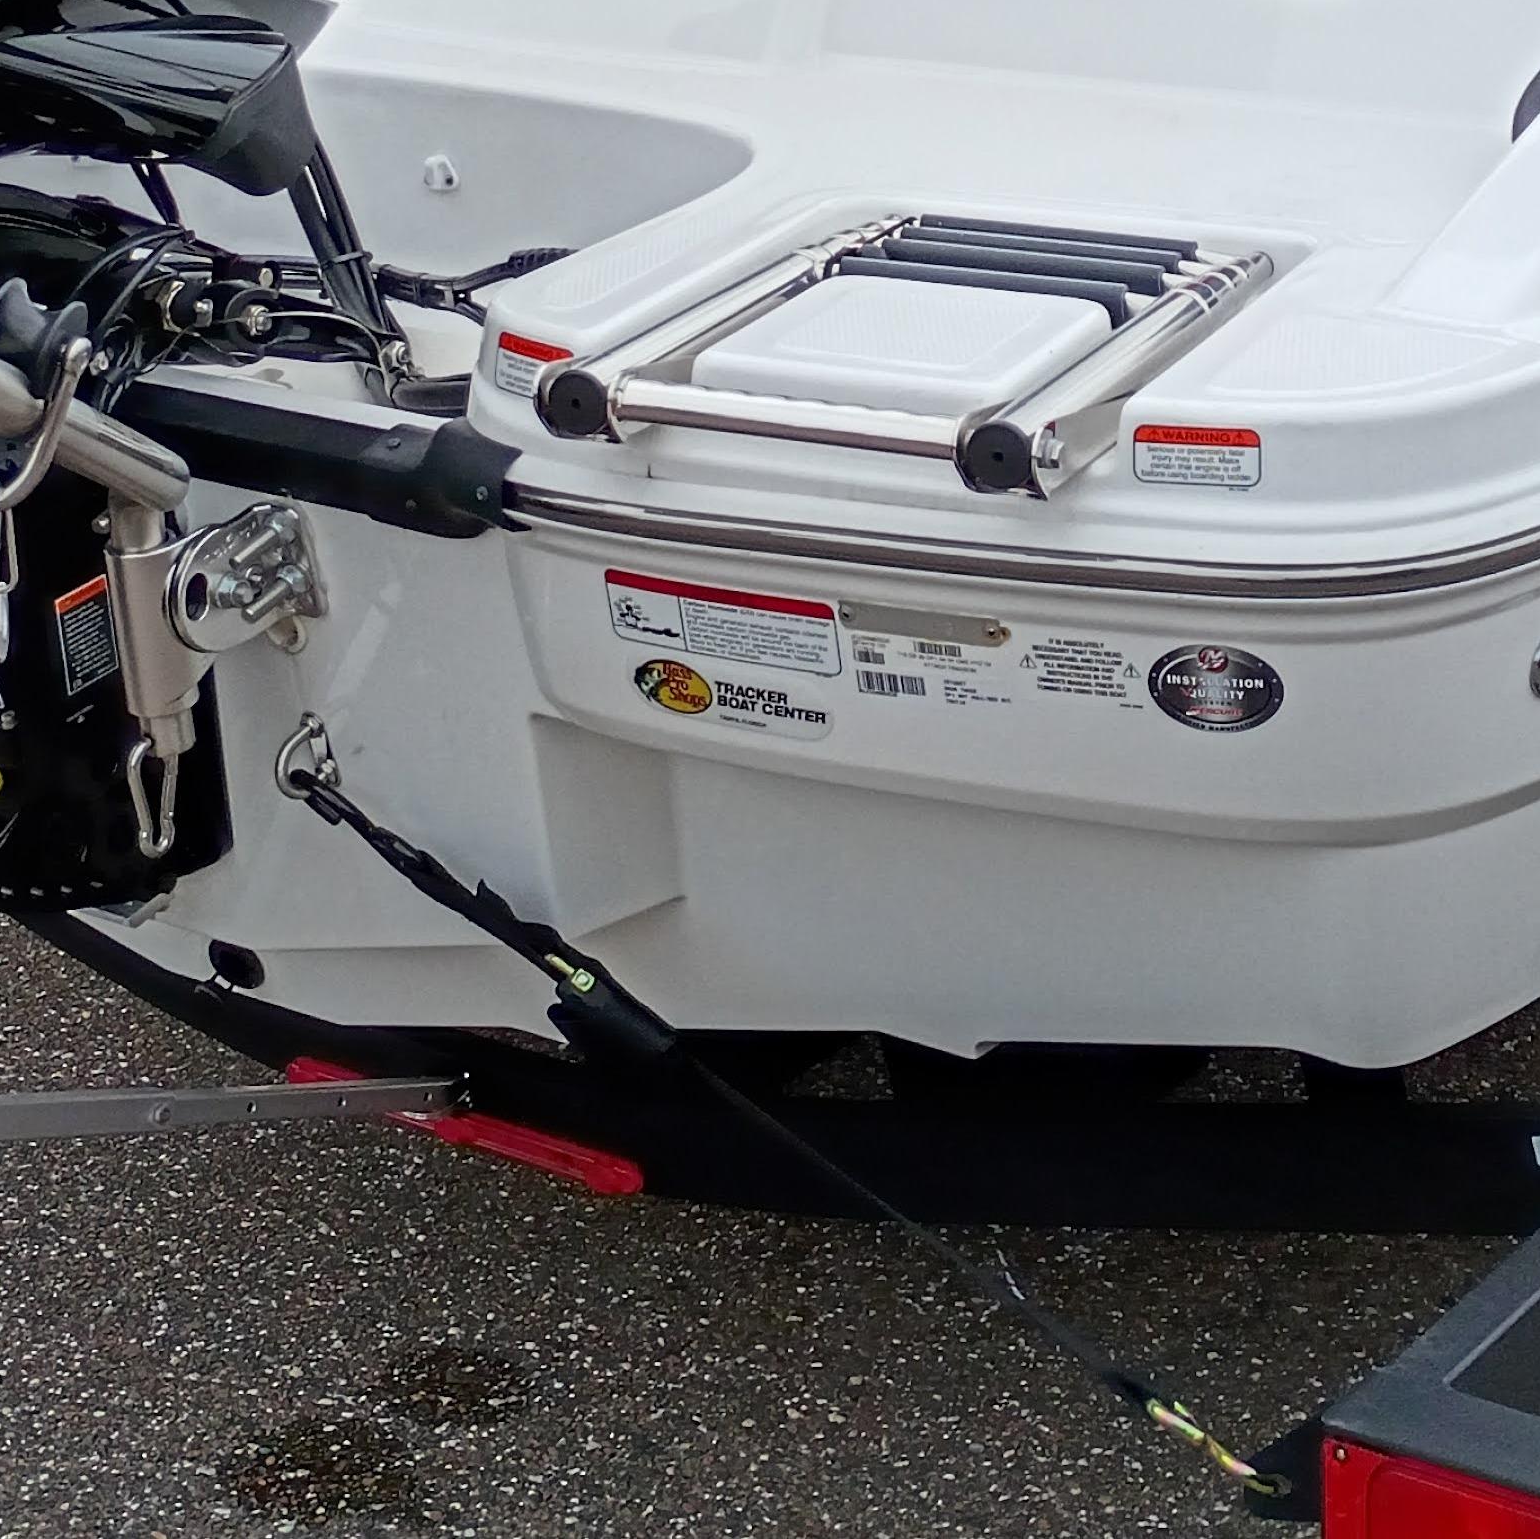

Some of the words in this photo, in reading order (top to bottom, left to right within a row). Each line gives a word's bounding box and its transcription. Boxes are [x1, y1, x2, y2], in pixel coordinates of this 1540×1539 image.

[1161, 430, 1231, 443] WARNING
[714, 680, 788, 705] TRACKER
[1189, 688, 1245, 700] QUALITY
[717, 694, 757, 711] BOAT
[762, 704, 826, 724] CENTER
